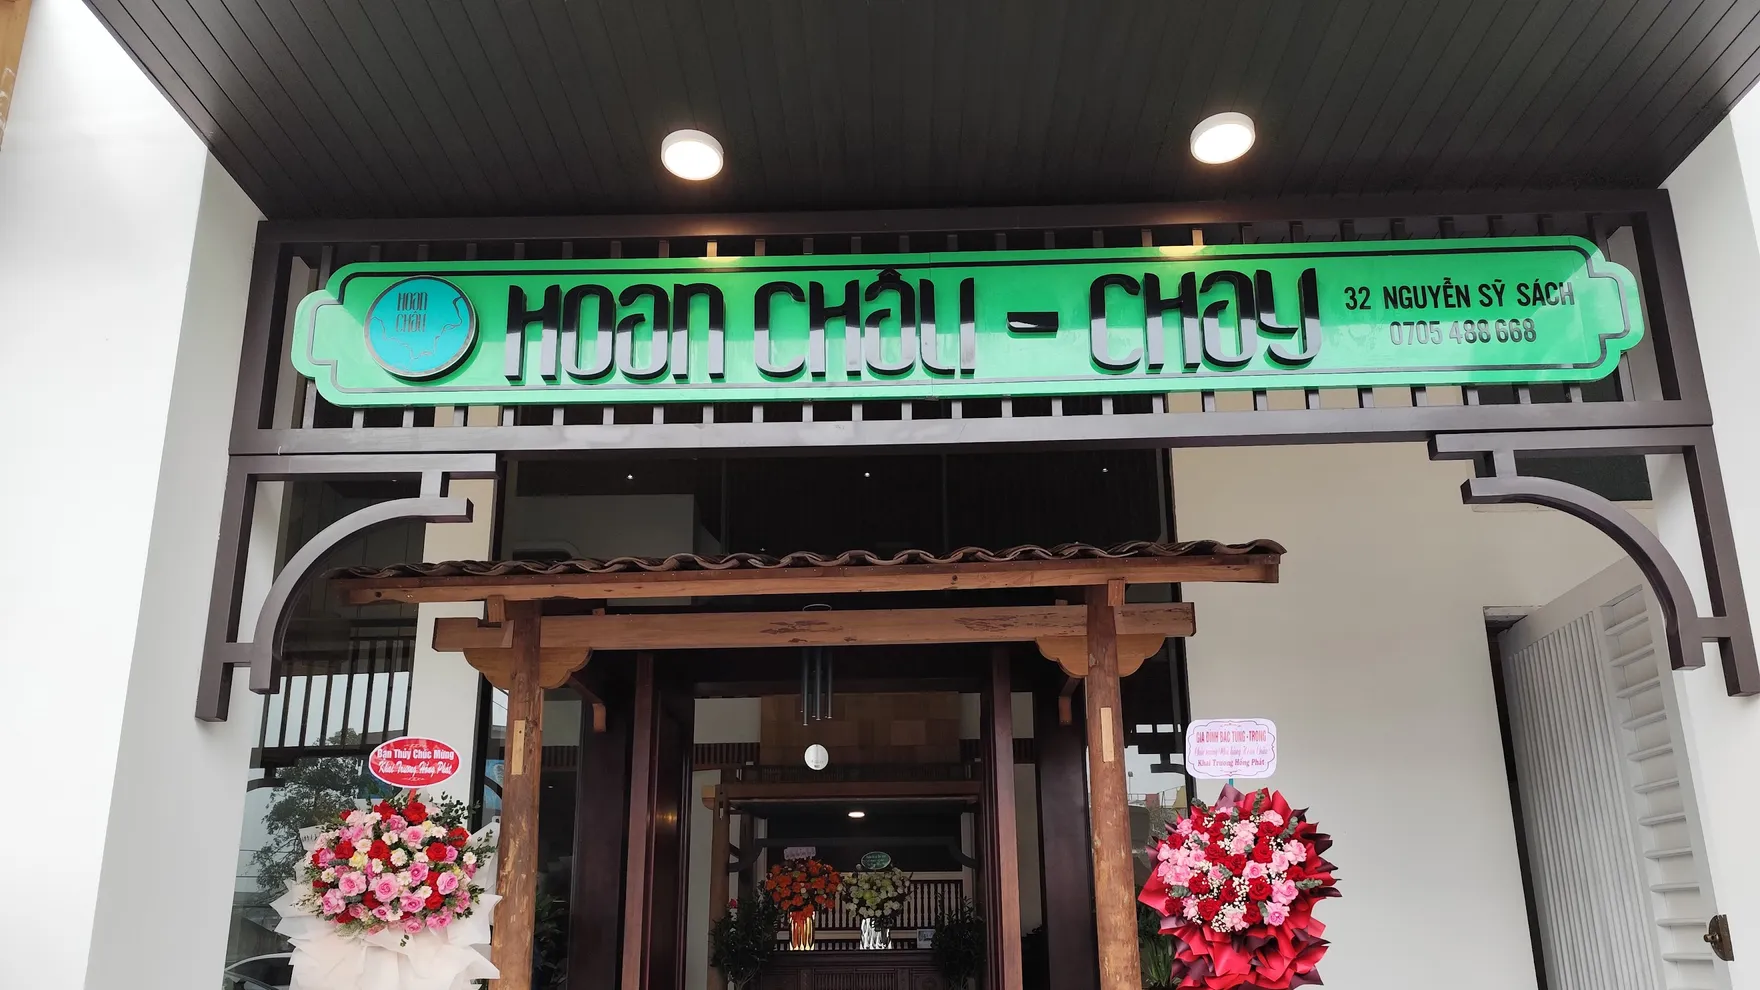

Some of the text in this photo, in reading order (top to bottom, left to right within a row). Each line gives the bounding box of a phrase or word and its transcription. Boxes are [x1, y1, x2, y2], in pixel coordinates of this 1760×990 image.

[1344, 277, 1575, 310] 32 NGUYỄN SỸ SÁCH
[1389, 318, 1537, 345] 0705 488 668
[1196, 731, 1205, 743] GIA
